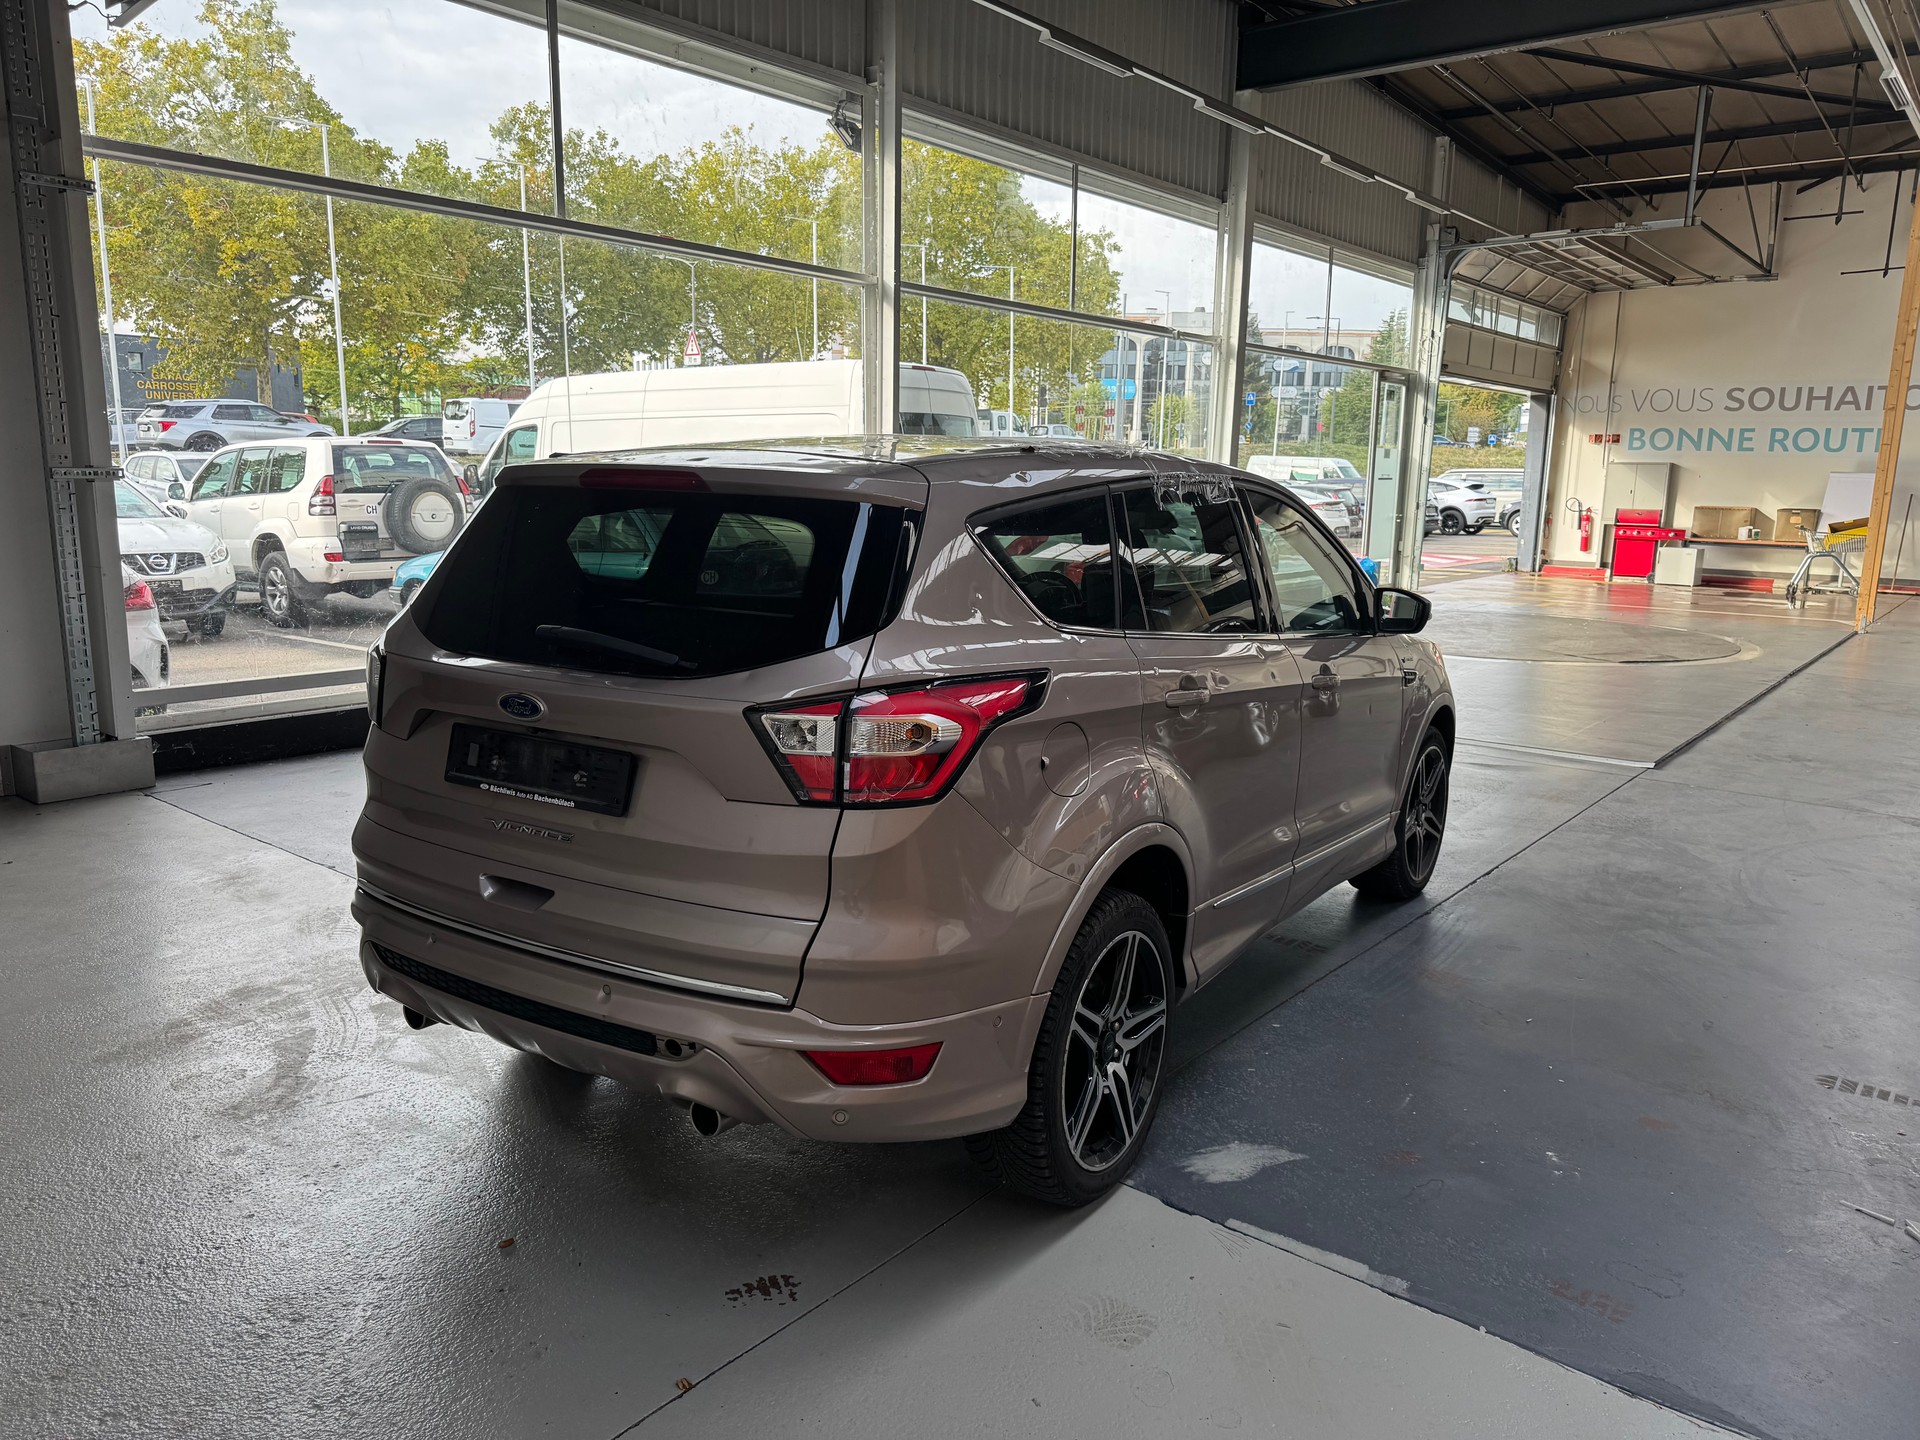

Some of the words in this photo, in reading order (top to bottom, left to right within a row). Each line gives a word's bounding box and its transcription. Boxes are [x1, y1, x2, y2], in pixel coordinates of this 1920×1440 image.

[136, 380, 198, 391] CARROSSE
[145, 390, 199, 400] UNIVERS
[1561, 394, 1622, 413] NOUS
[1631, 387, 1714, 413] VOUS
[1627, 427, 1756, 452] BONNE
[366, 505, 378, 514] CH
[703, 571, 716, 583] CH
